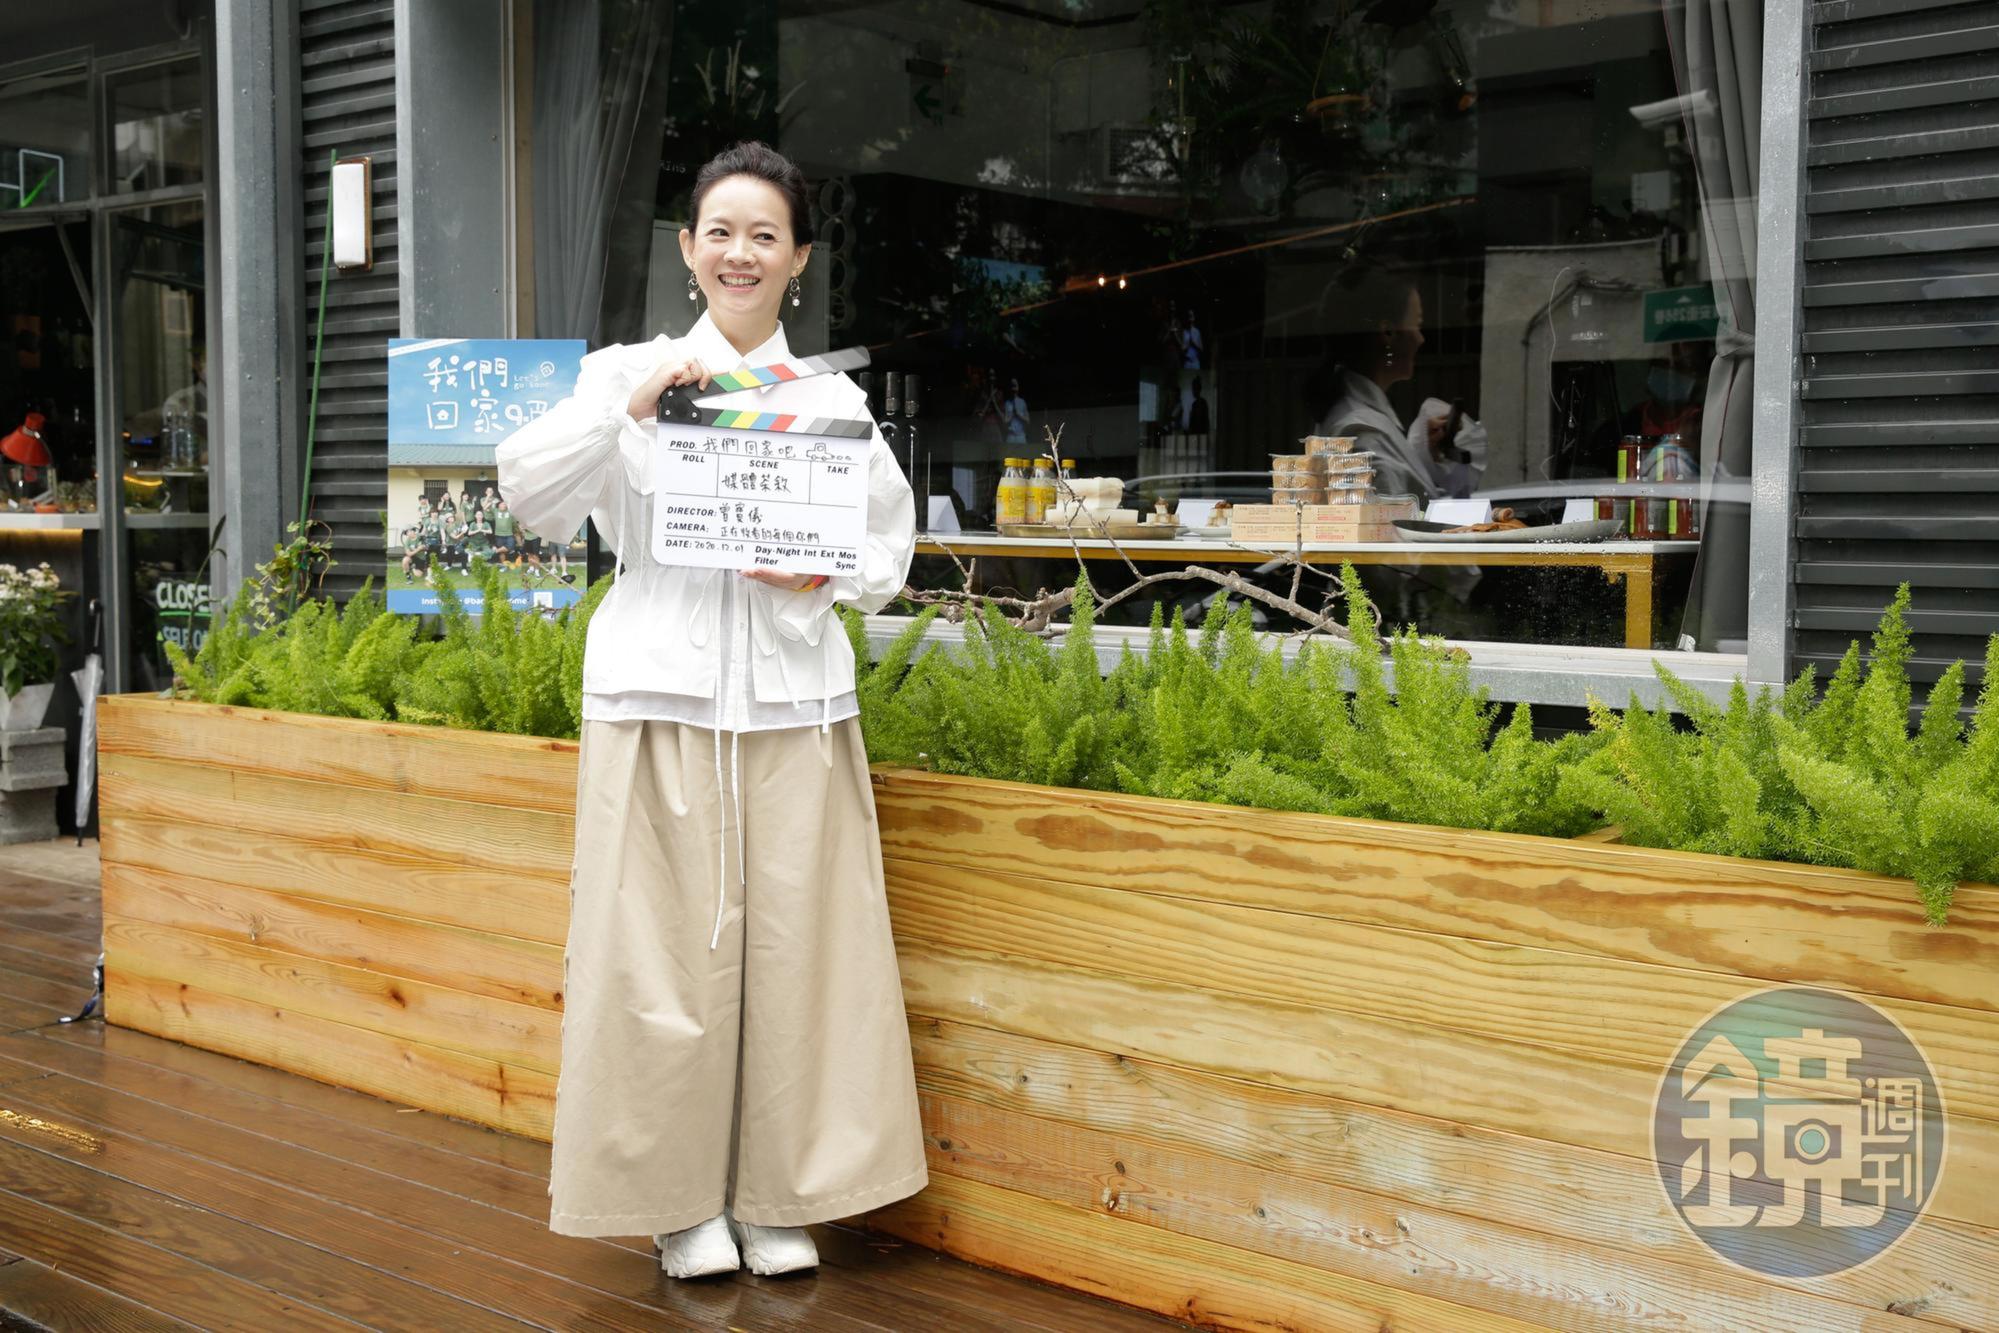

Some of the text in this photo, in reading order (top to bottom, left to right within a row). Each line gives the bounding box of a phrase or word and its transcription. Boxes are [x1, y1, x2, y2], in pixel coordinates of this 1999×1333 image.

[423, 355, 508, 393] 我們
[669, 440, 697, 449] PROD.
[702, 436, 797, 459] 我們回家吧
[682, 454, 705, 463] ROLL
[749, 460, 779, 469] SCENE
[827, 465, 850, 475] TAKE
[667, 506, 717, 517] DIRECTOR:
[666, 522, 709, 533] CAMERA:
[665, 539, 692, 549] DATE:
[804, 549, 817, 557] Int
[820, 550, 835, 558] Ext
[838, 551, 857, 560] Mos
[754, 556, 779, 566] Filter
[835, 561, 857, 571] Sync
[156, 582, 211, 612] CLOSE
